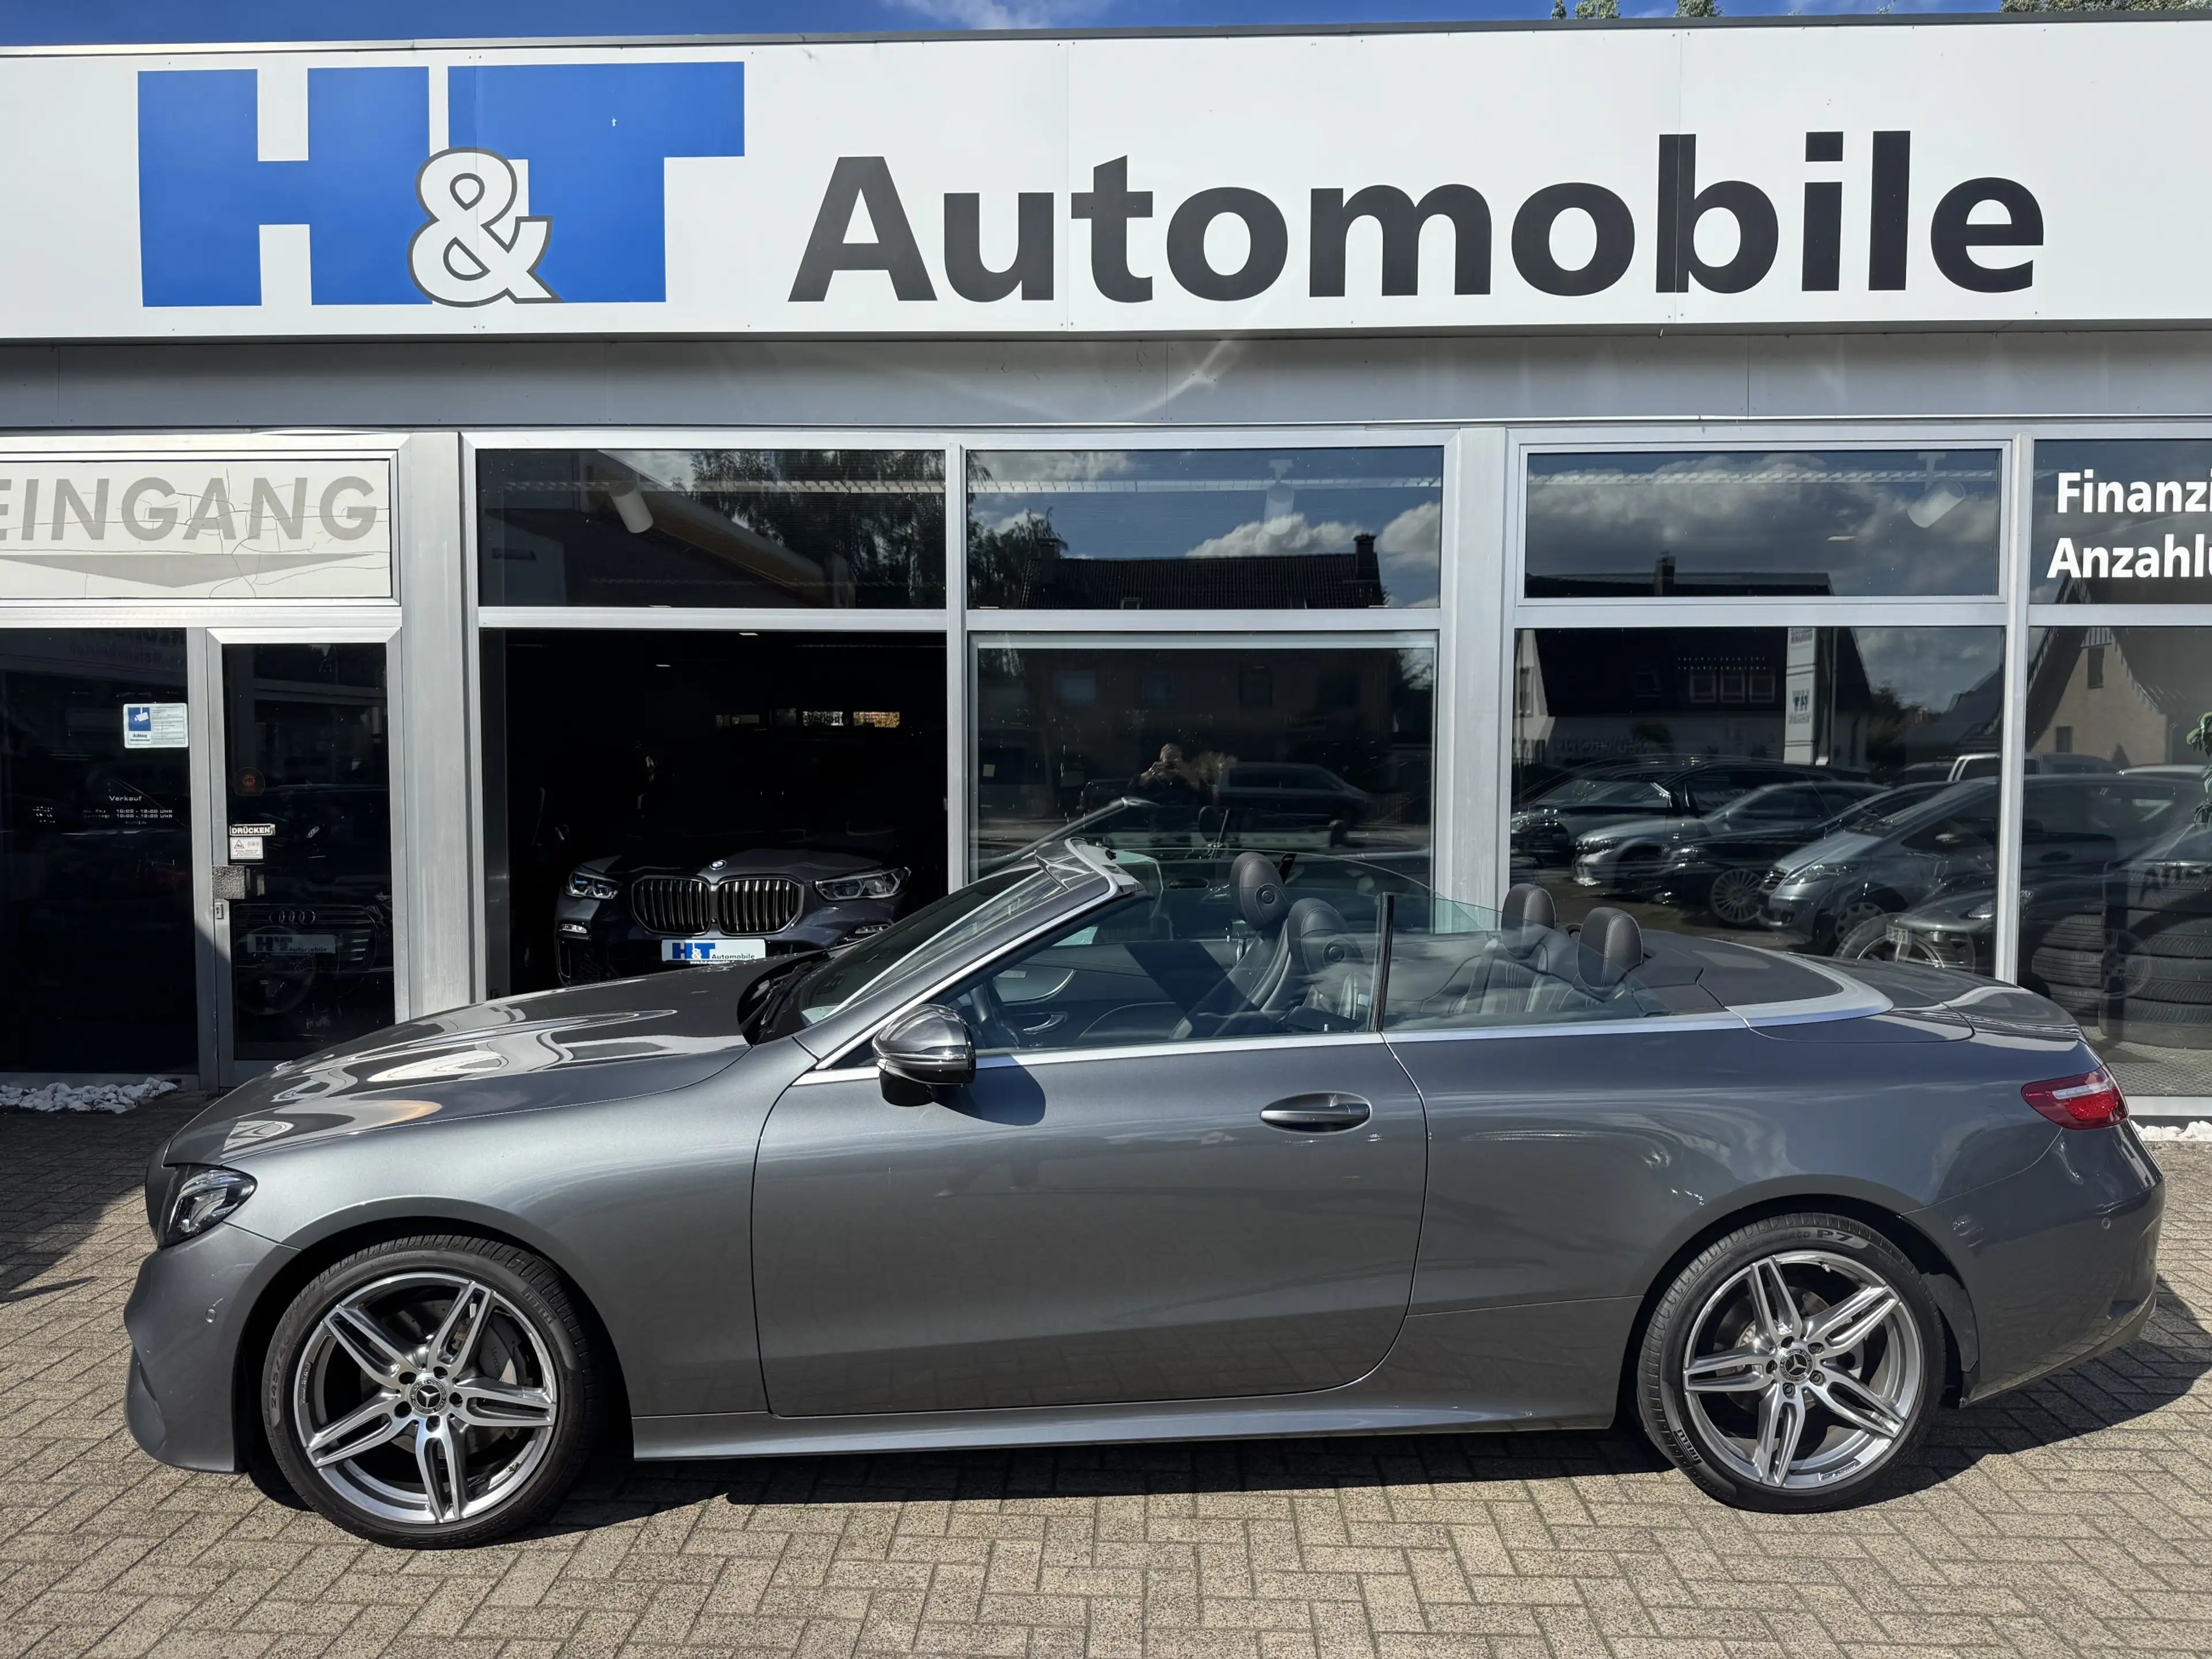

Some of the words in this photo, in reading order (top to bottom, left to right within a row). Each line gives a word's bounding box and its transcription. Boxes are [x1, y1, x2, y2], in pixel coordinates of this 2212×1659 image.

[137, 61, 744, 307] H&T
[787, 130, 2044, 304] Automobile
[2058, 468, 2212, 513] Finanz
[2046, 533, 2212, 578] Anzahl
[232, 826, 270, 834] DRÜCKEN
[672, 942, 715, 959] H&T
[1817, 1229, 1854, 1242] P7
[1672, 1429, 1703, 1464] PIRELLI
